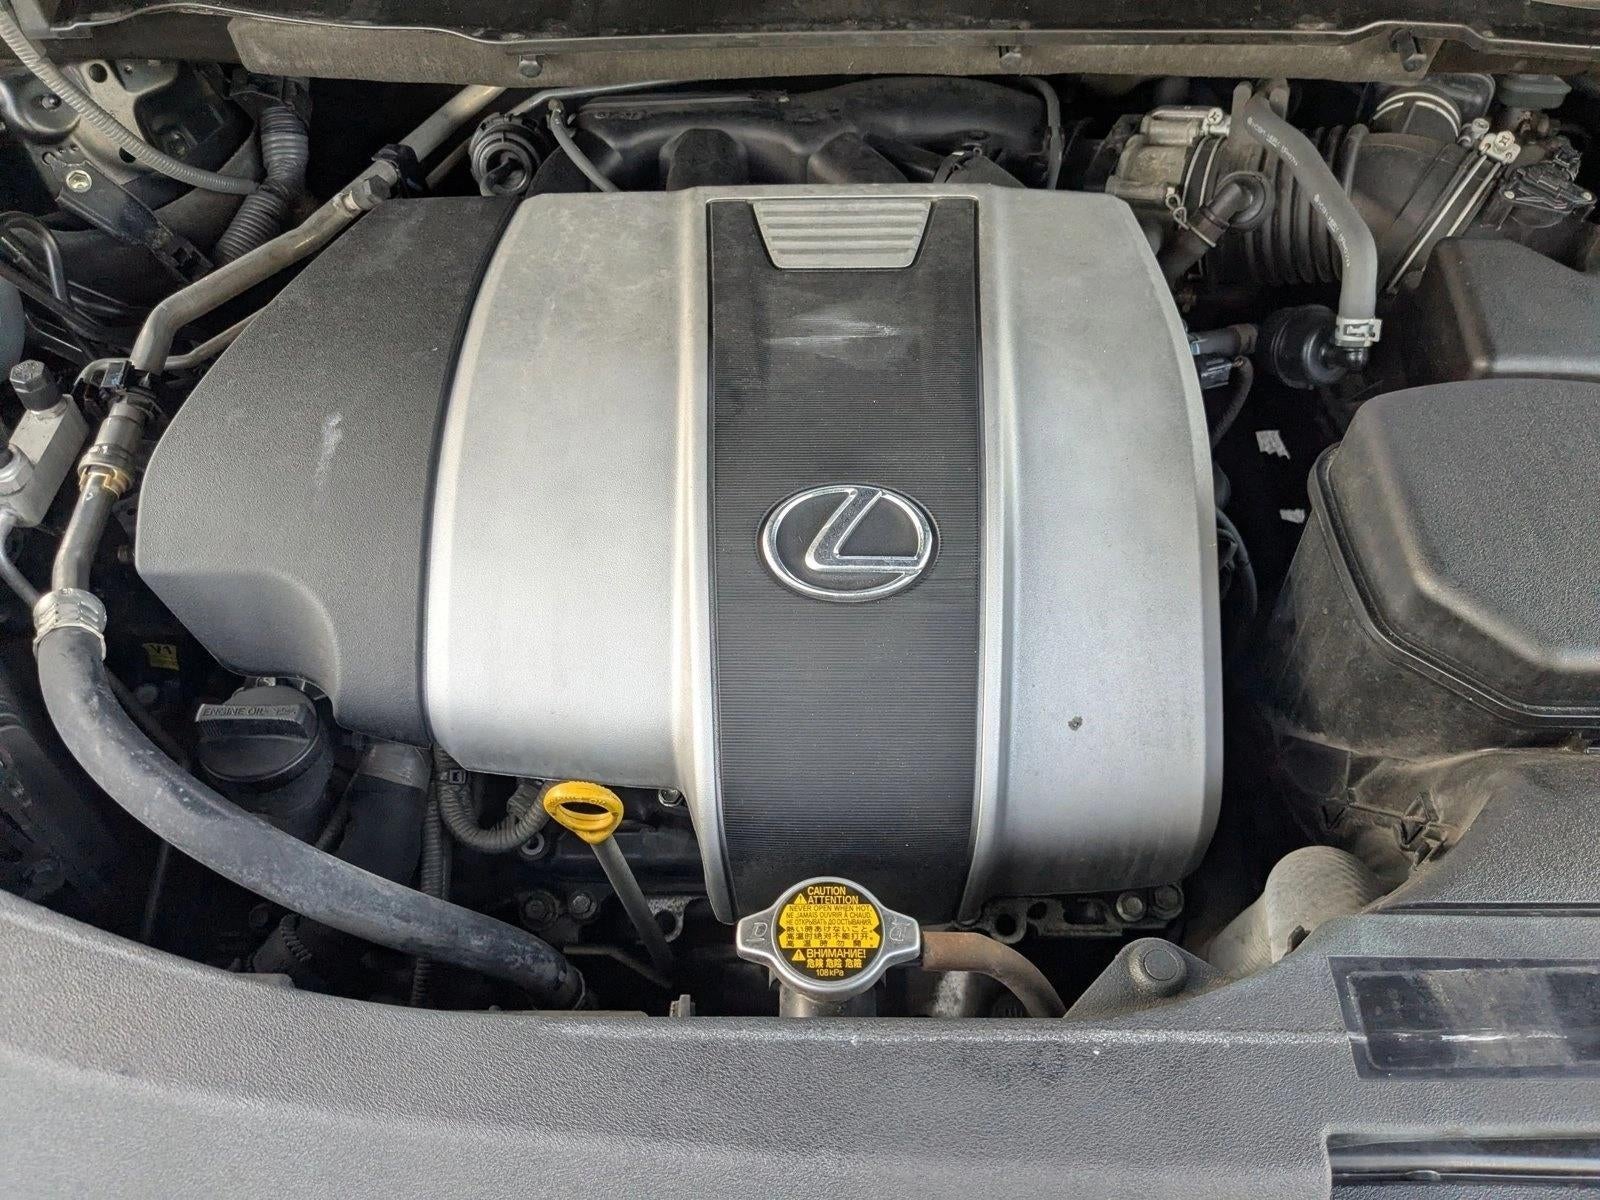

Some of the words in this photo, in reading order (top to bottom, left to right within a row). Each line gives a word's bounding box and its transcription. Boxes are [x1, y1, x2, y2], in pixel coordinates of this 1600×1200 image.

[202, 706, 246, 717] ENGINE
[807, 886, 846, 896] CAUTION
[807, 895, 859, 904] ATTENTION
[806, 948, 867, 958] ВНИМАНИЕ!
